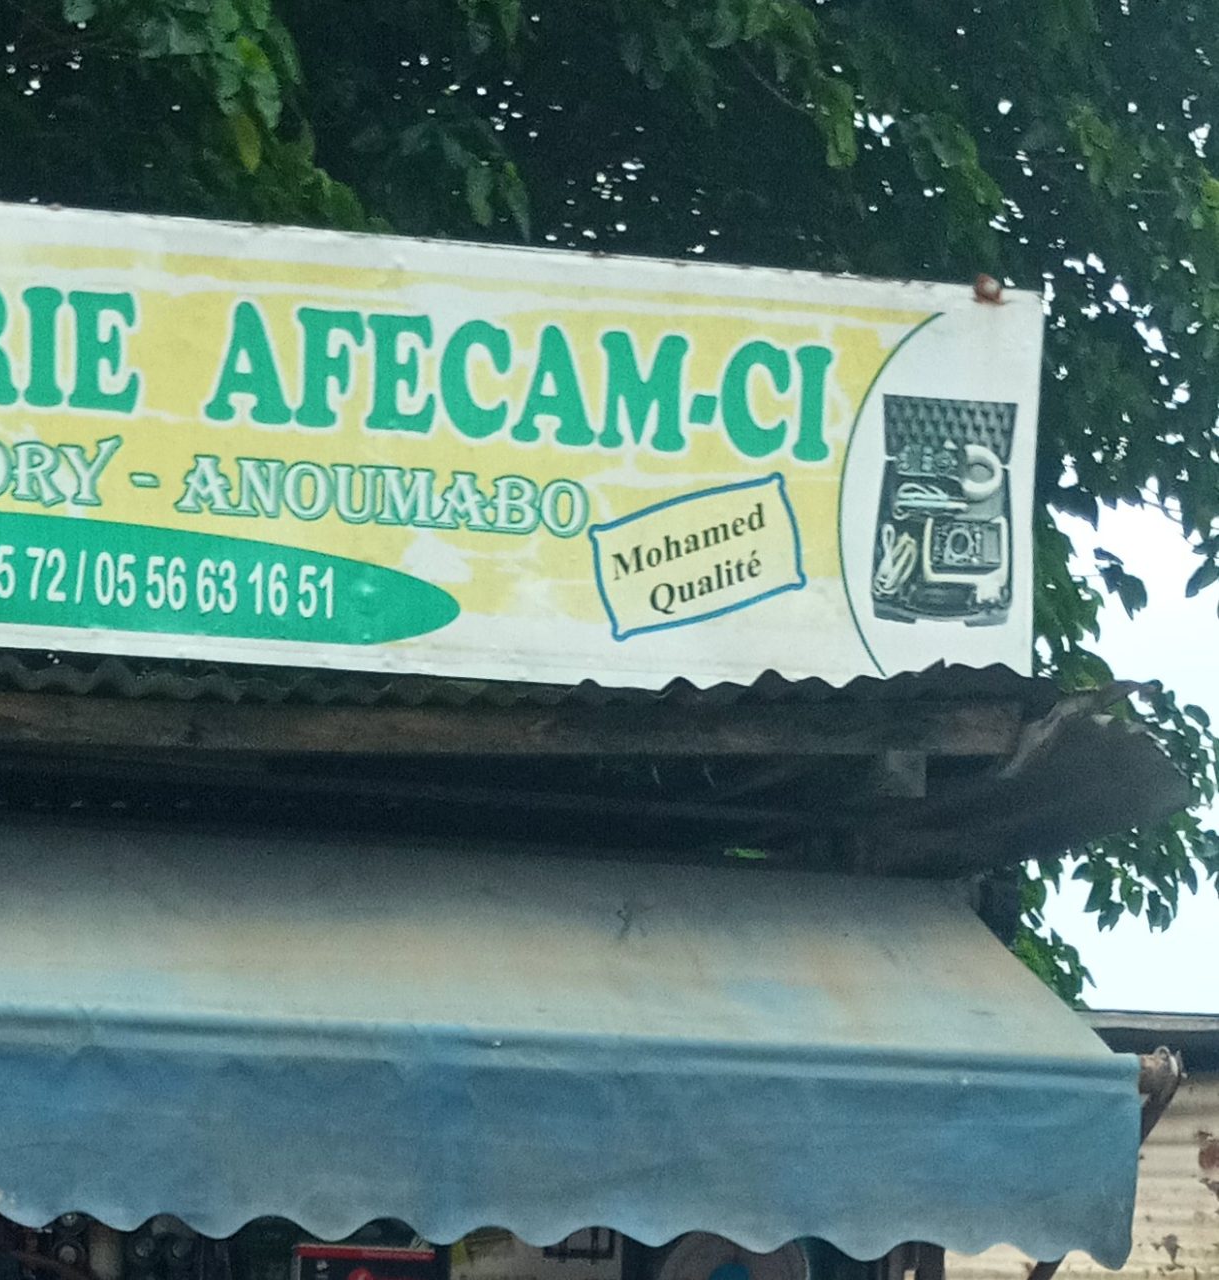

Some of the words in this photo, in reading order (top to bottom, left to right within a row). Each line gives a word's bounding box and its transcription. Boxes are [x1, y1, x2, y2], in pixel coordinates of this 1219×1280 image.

[205, 302, 833, 461] AFECAM-CI
[176, 455, 589, 537] ANOUMABO
[611, 503, 767, 581] Mohamed
[26, 547, 67, 603] 72
[96, 553, 137, 608] 05
[146, 556, 187, 611] 56
[196, 559, 237, 614] 63
[248, 563, 289, 618] 16
[298, 565, 336, 620] 51
[648, 549, 763, 615] Qualité
